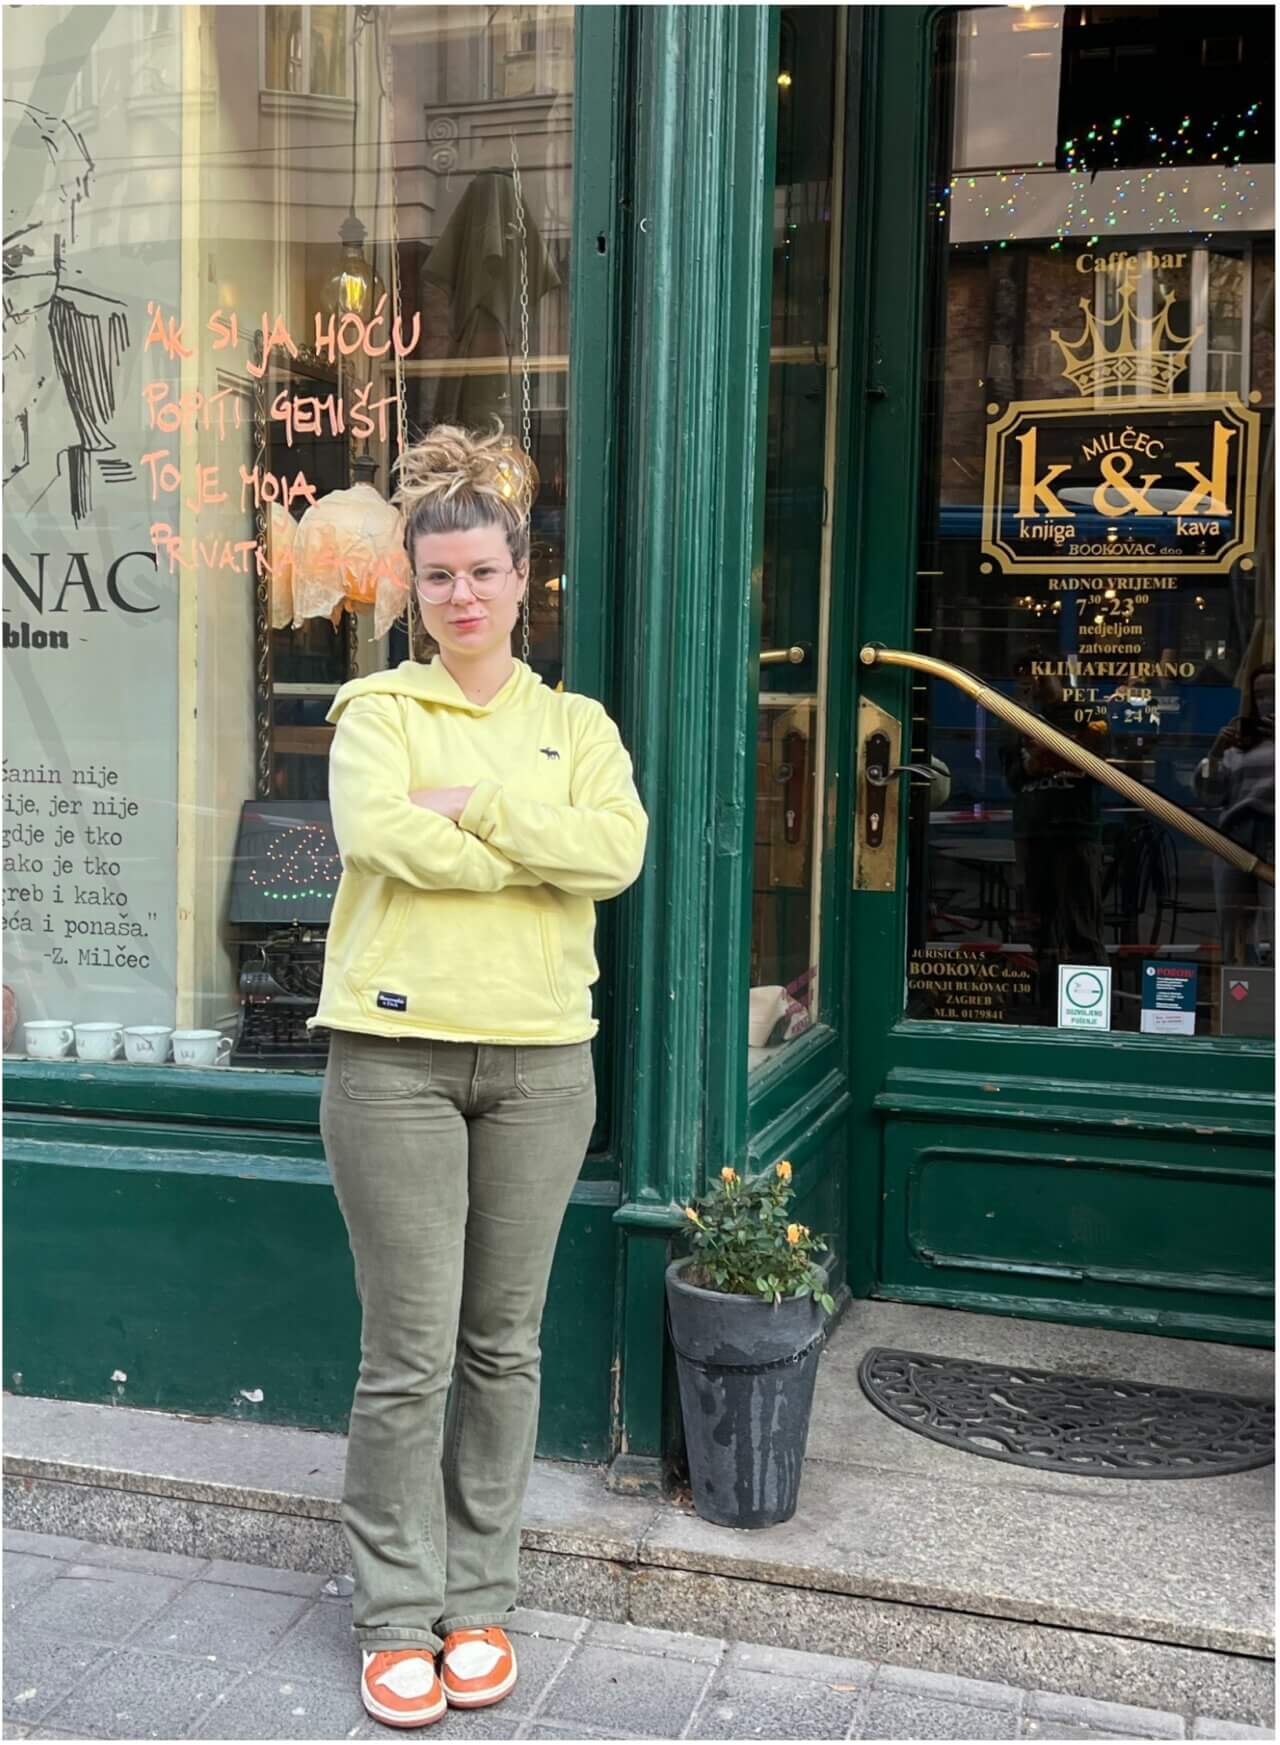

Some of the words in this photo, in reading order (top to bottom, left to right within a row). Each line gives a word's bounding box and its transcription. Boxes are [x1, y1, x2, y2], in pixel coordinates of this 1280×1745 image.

[1076, 251, 1137, 273] Caffe
[1146, 250, 1187, 269] bar
[208, 309, 238, 350] SI
[246, 311, 297, 378] JA
[315, 294, 421, 363] HOĆU
[143, 382, 241, 443] POPITI
[271, 382, 399, 447] GEMIŠT
[1082, 425, 1164, 461] MILČEC
[141, 450, 181, 501] TO
[185, 463, 228, 513] JE
[240, 465, 320, 530] MOJA
[1020, 520, 1076, 546] knjiga
[1176, 517, 1221, 537] kava
[1069, 544, 1156, 556] BOOKOVAC
[2, 551, 160, 615] NAC
[1048, 578, 1103, 590] RADNO
[1107, 577, 1178, 590] VRIJEME
[2, 622, 69, 649] blon
[1079, 622, 1143, 637] nedjeljom
[1079, 643, 1141, 654] zatvoreno
[1031, 661, 1195, 678] KLIMATIZIRANO
[1063, 688, 1099, 702] PET
[72, 766, 118, 789] nije
[2, 794, 40, 816] ije,
[49, 796, 82, 817] jer
[93, 797, 139, 819] nije
[2, 824, 45, 848] gdje
[55, 825, 75, 847] je
[85, 826, 123, 846] tko
[53, 855, 73, 877] je
[84, 856, 121, 876] tko
[2, 884, 44, 905] reb
[53, 885, 64, 903] i
[75, 886, 128, 906] kako
[43, 914, 54, 932] i
[78, 945, 150, 968] Milčec
[910, 962, 1000, 977] BOOKOVAC
[908, 980, 952, 991] GORNJI
[956, 981, 1009, 993] BUKOVAC
[946, 995, 992, 1005] ZAGREB
